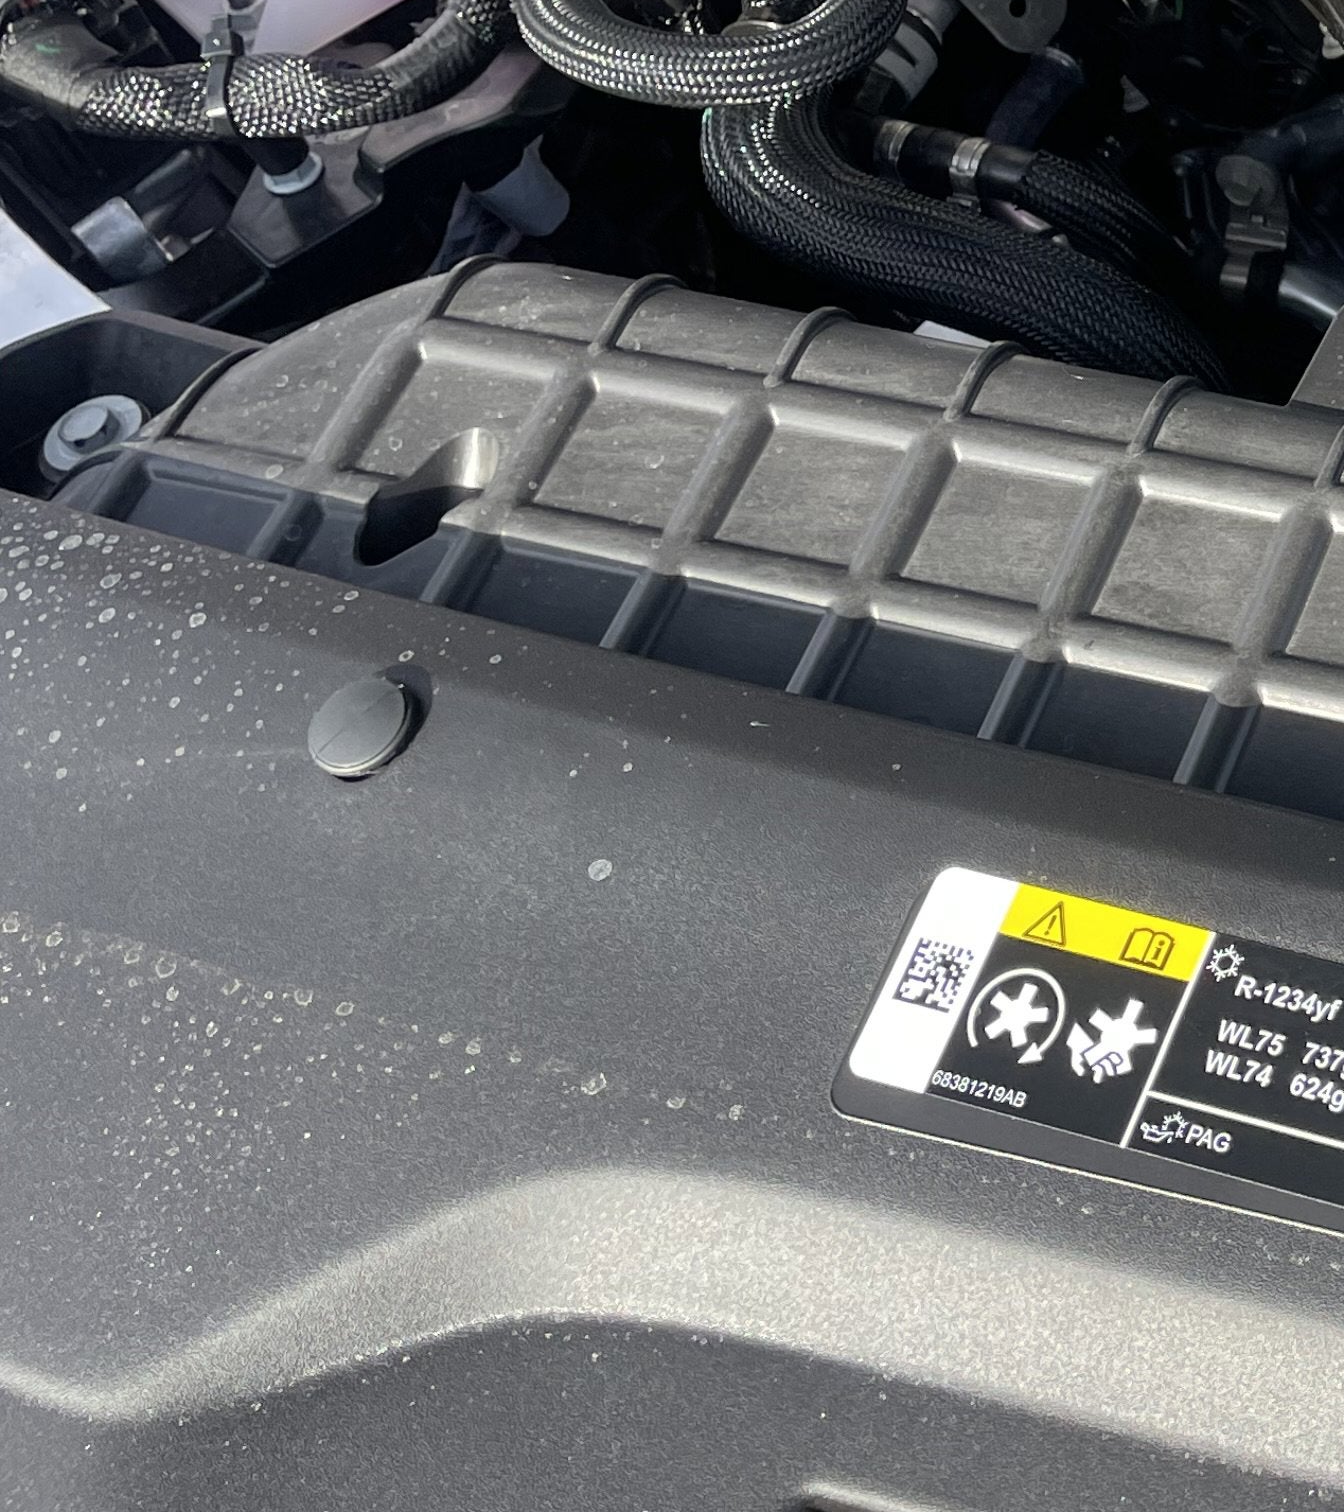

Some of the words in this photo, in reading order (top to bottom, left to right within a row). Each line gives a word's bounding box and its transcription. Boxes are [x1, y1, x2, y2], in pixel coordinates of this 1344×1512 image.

[1234, 975, 1343, 1022] R-1234yf
[1217, 1019, 1286, 1056] WL75
[1205, 1050, 1273, 1088] WL74
[932, 1069, 1027, 1108] 68381219AB
[1186, 1124, 1231, 1153] PAG
